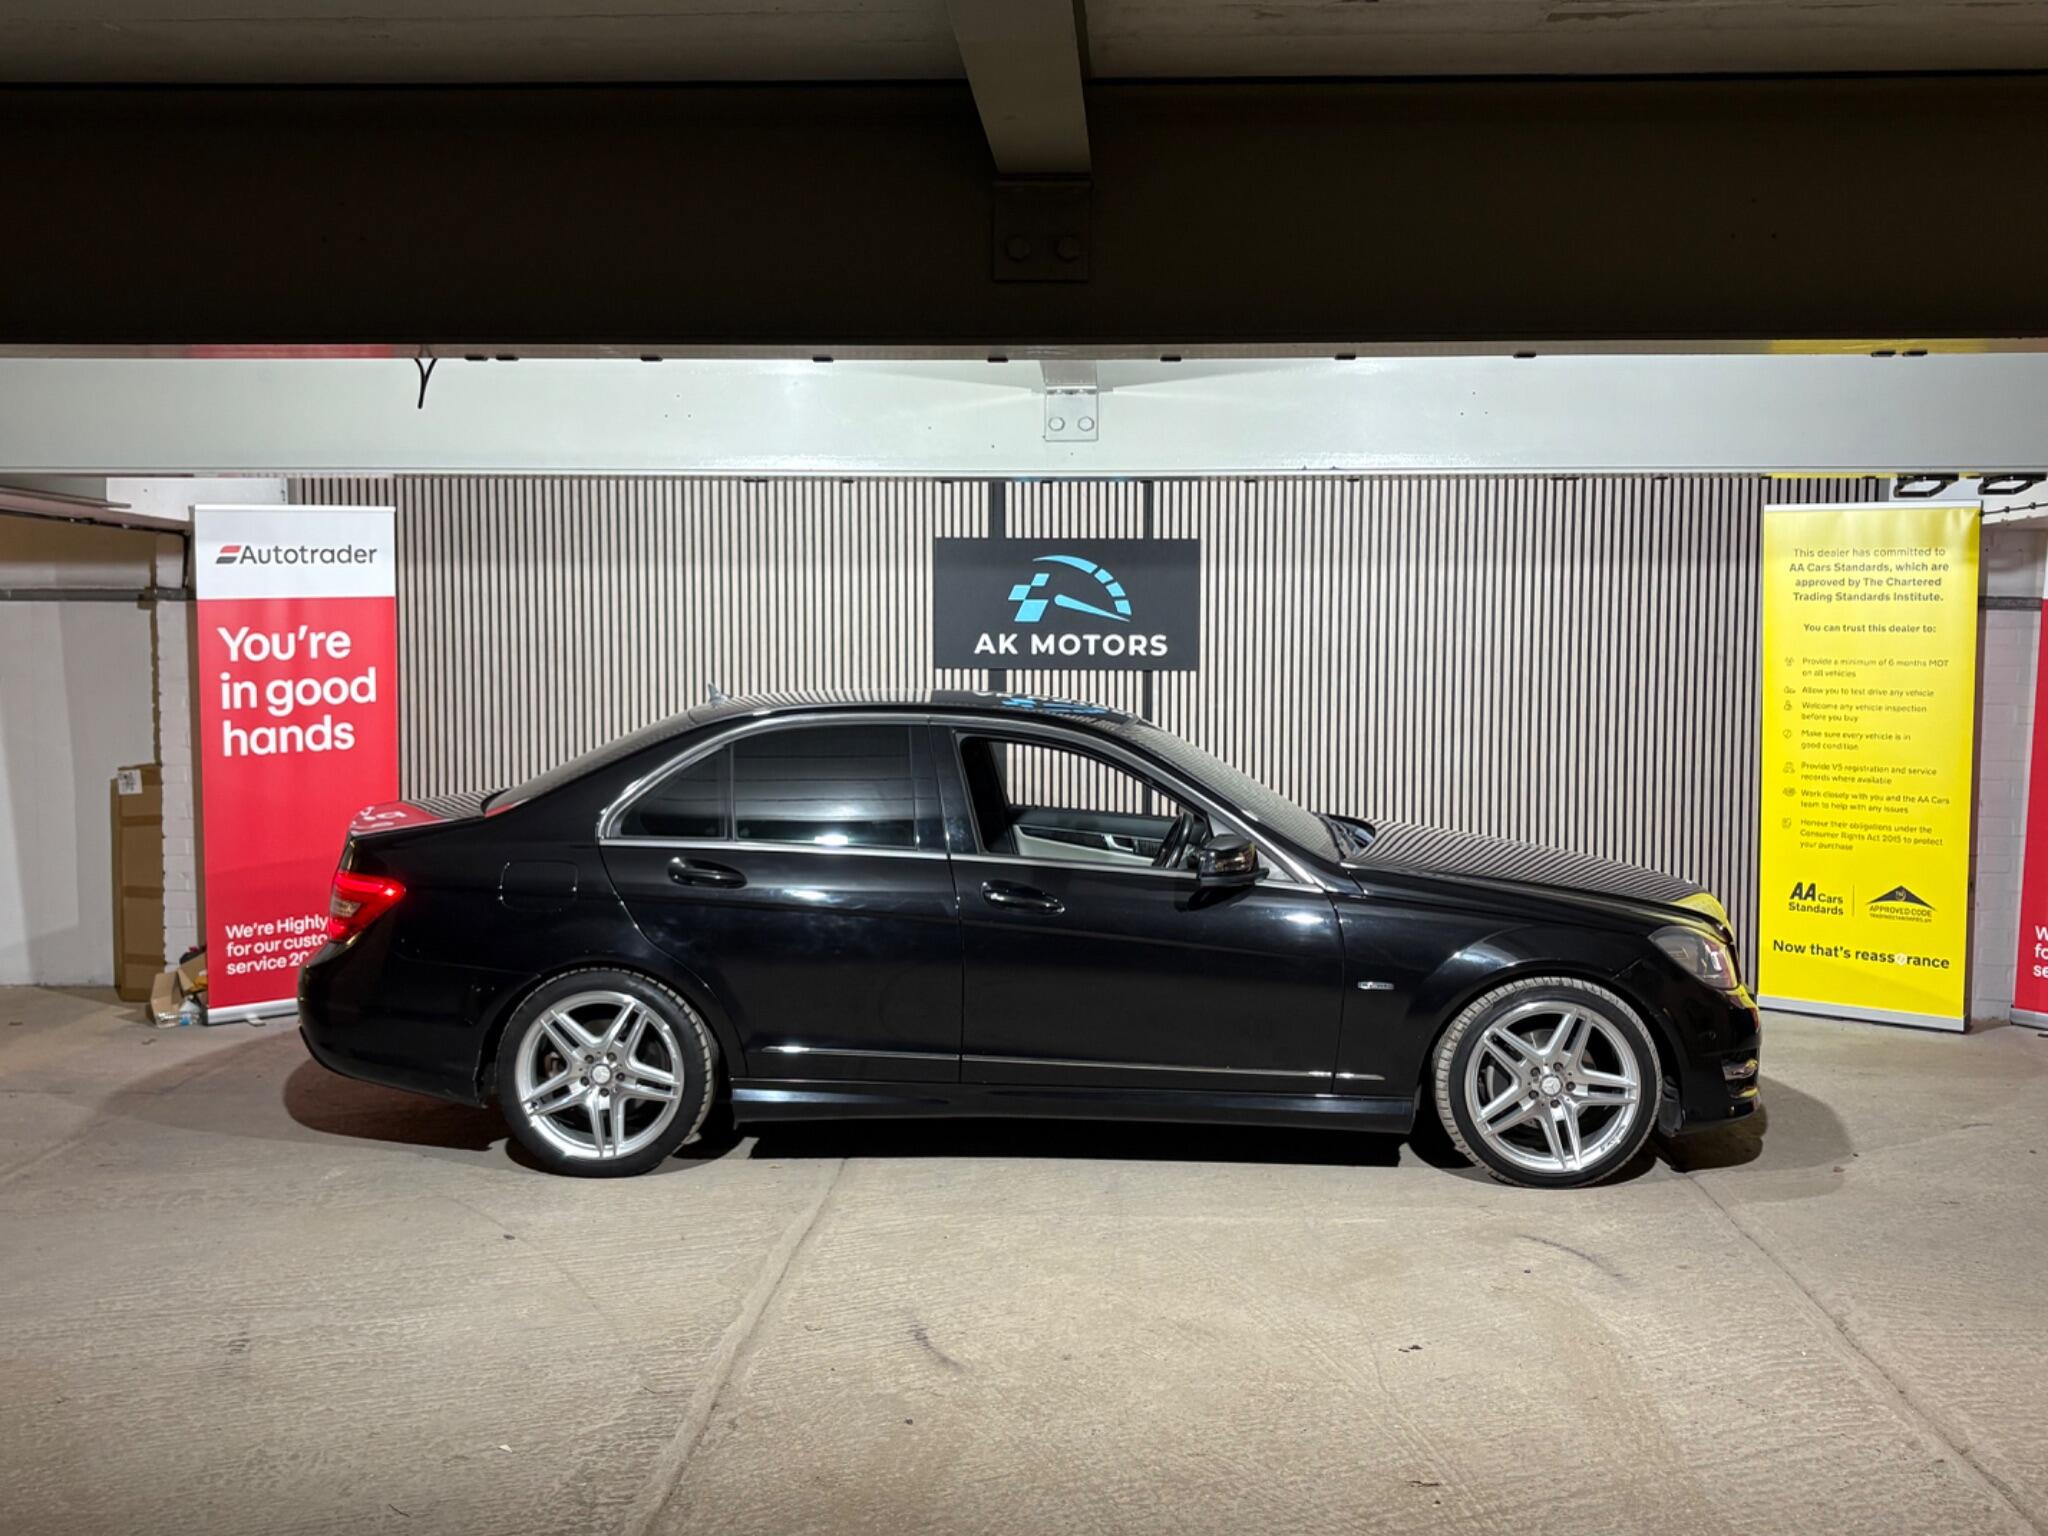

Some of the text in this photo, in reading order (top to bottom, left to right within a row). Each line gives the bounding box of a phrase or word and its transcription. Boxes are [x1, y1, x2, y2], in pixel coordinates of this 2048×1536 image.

[240, 544, 378, 564] Autotrader
[1794, 547, 1945, 557] This dealer has committed to
[1790, 563, 1804, 572] AA
[1807, 563, 1831, 572] Cars
[1834, 563, 1892, 572] Standards,
[1896, 563, 1928, 571] which
[1795, 577, 1941, 588] approved by The Chartered
[1793, 592, 1943, 602] Trading Standards Institute.
[1843, 624, 1865, 632] trust
[1869, 624, 1885, 632] this
[1889, 624, 1920, 632] dealer
[217, 625, 351, 662] You're
[974, 633, 1168, 656] AK MOTORS
[1879, 658, 1887, 666] of
[1929, 659, 1948, 667] MOT
[220, 666, 376, 716] in good
[1802, 686, 1823, 694] Allow
[1802, 702, 1837, 710] Welcome
[1885, 704, 1927, 713] inspection
[1801, 713, 1826, 721] before
[1844, 714, 1858, 722] buy
[223, 714, 355, 757] hands
[1843, 732, 1863, 740] every
[1866, 732, 1892, 740] vehicle
[1801, 742, 1858, 750] good condition
[1801, 762, 1936, 775] Provide V5 registration and service
[1801, 773, 1892, 784] records where available
[1801, 789, 1949, 804] Work closely with you and the AA Cars
[1831, 802, 1848, 811] help
[1850, 803, 1866, 811] with
[1884, 805, 1908, 814] issues
[1801, 819, 1828, 827] Honour
[1850, 822, 1892, 832] obligations
[1894, 824, 1916, 833] under
[1919, 825, 1932, 833] the
[1800, 830, 1943, 847] Consumer Rights Act 2015 to protect
[1819, 842, 1853, 850] purchase
[1790, 882, 1843, 904] AA Cars
[1789, 902, 1843, 915] Standards
[225, 914, 328, 939] We're Highly
[227, 942, 251, 957] for
[254, 940, 281, 954] our
[1773, 939, 1949, 968] Now that's reassrance
[227, 956, 287, 975] service
